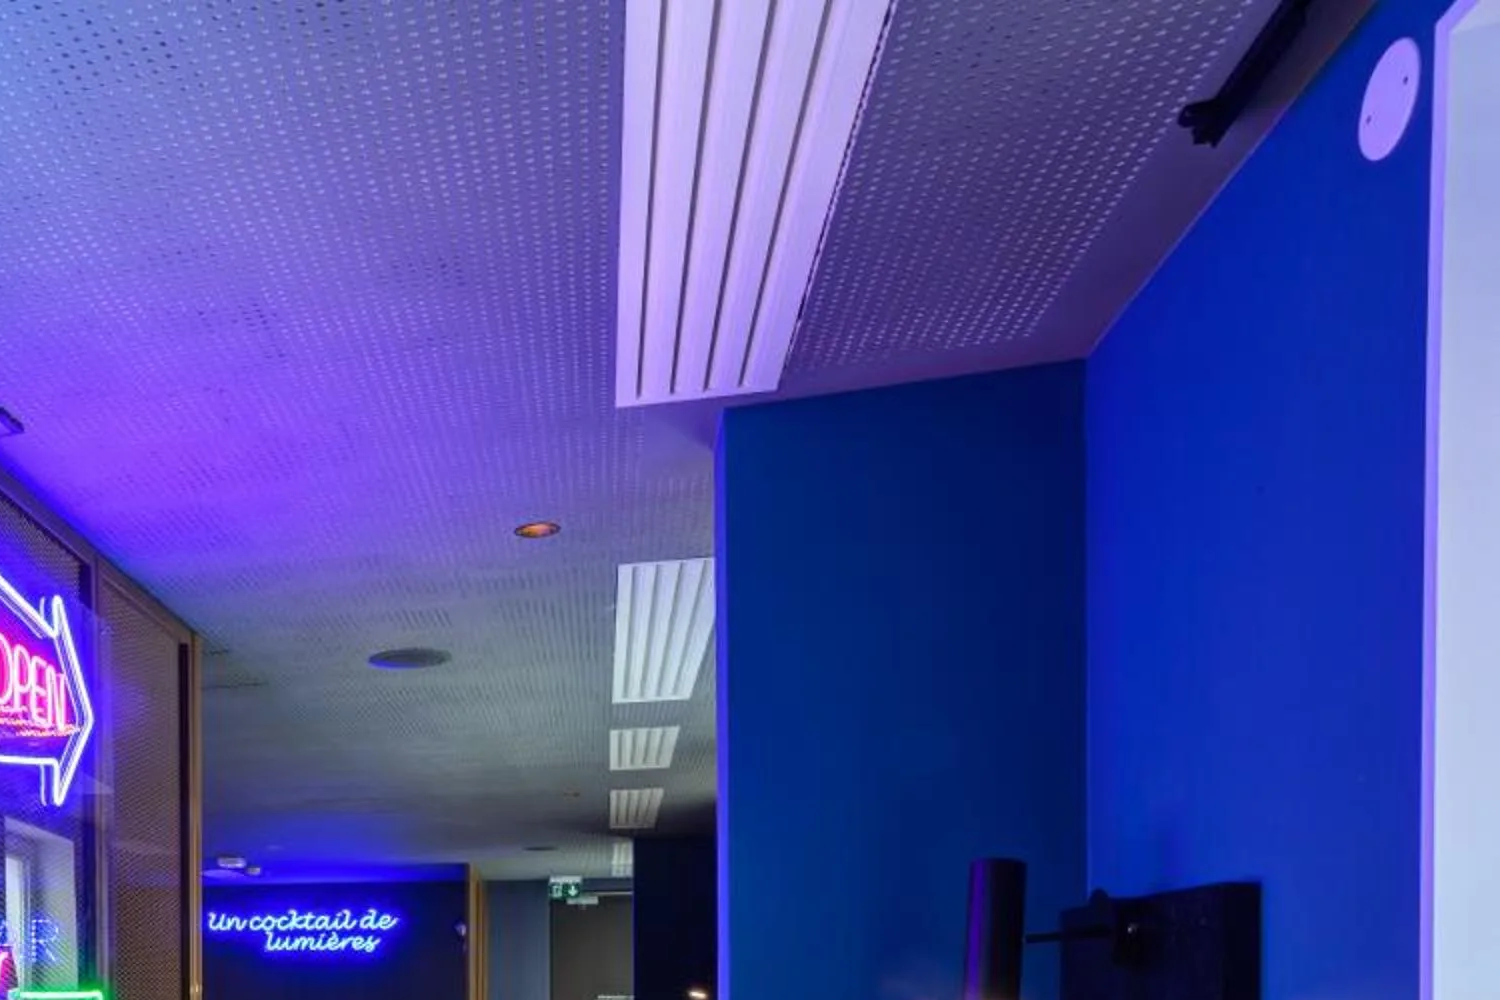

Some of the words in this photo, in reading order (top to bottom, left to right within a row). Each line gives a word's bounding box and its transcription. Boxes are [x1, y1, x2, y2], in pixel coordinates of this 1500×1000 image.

[249, 908, 357, 931] cocktail
[360, 908, 399, 930] de
[265, 931, 381, 952] lumières
